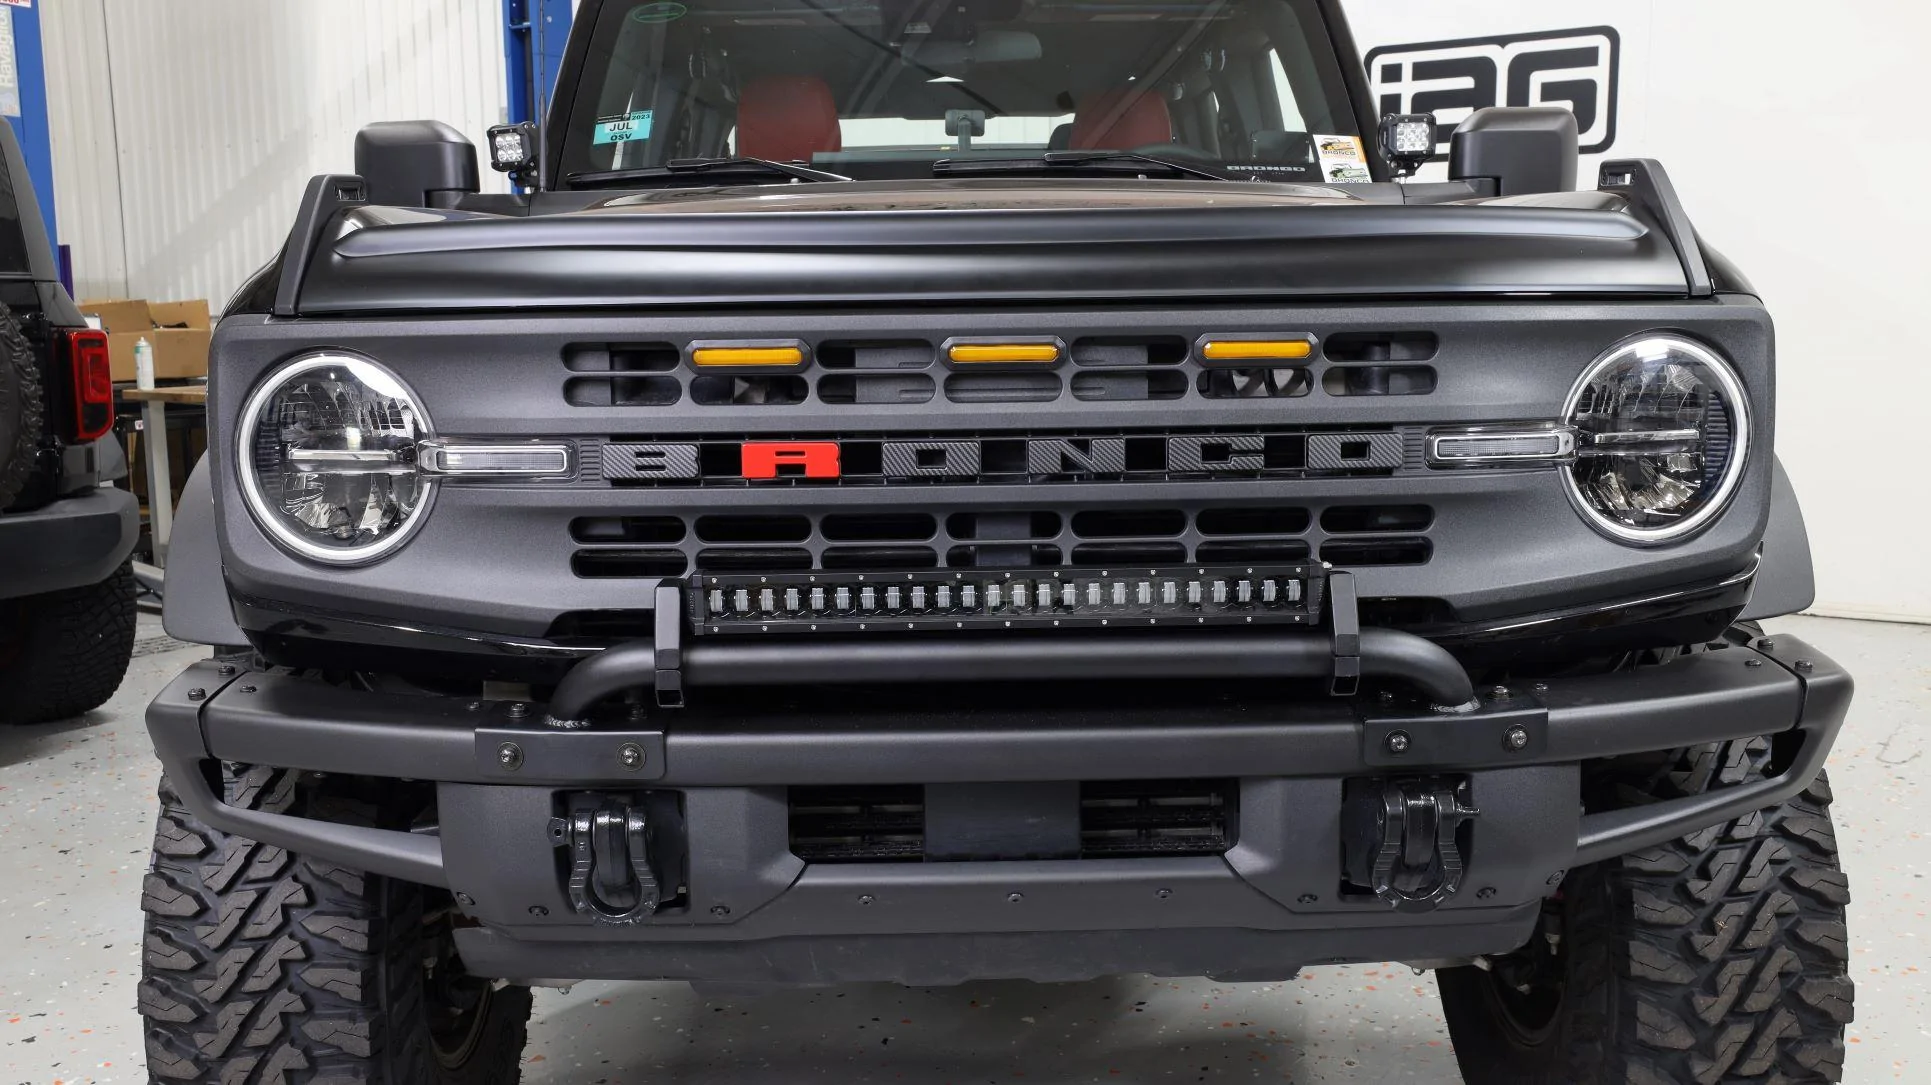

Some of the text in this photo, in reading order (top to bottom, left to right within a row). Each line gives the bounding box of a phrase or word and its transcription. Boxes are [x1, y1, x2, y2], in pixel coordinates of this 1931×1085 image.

[609, 122, 632, 132] JUL
[610, 133, 632, 141] OSV
[602, 433, 1404, 480] BRONCO
